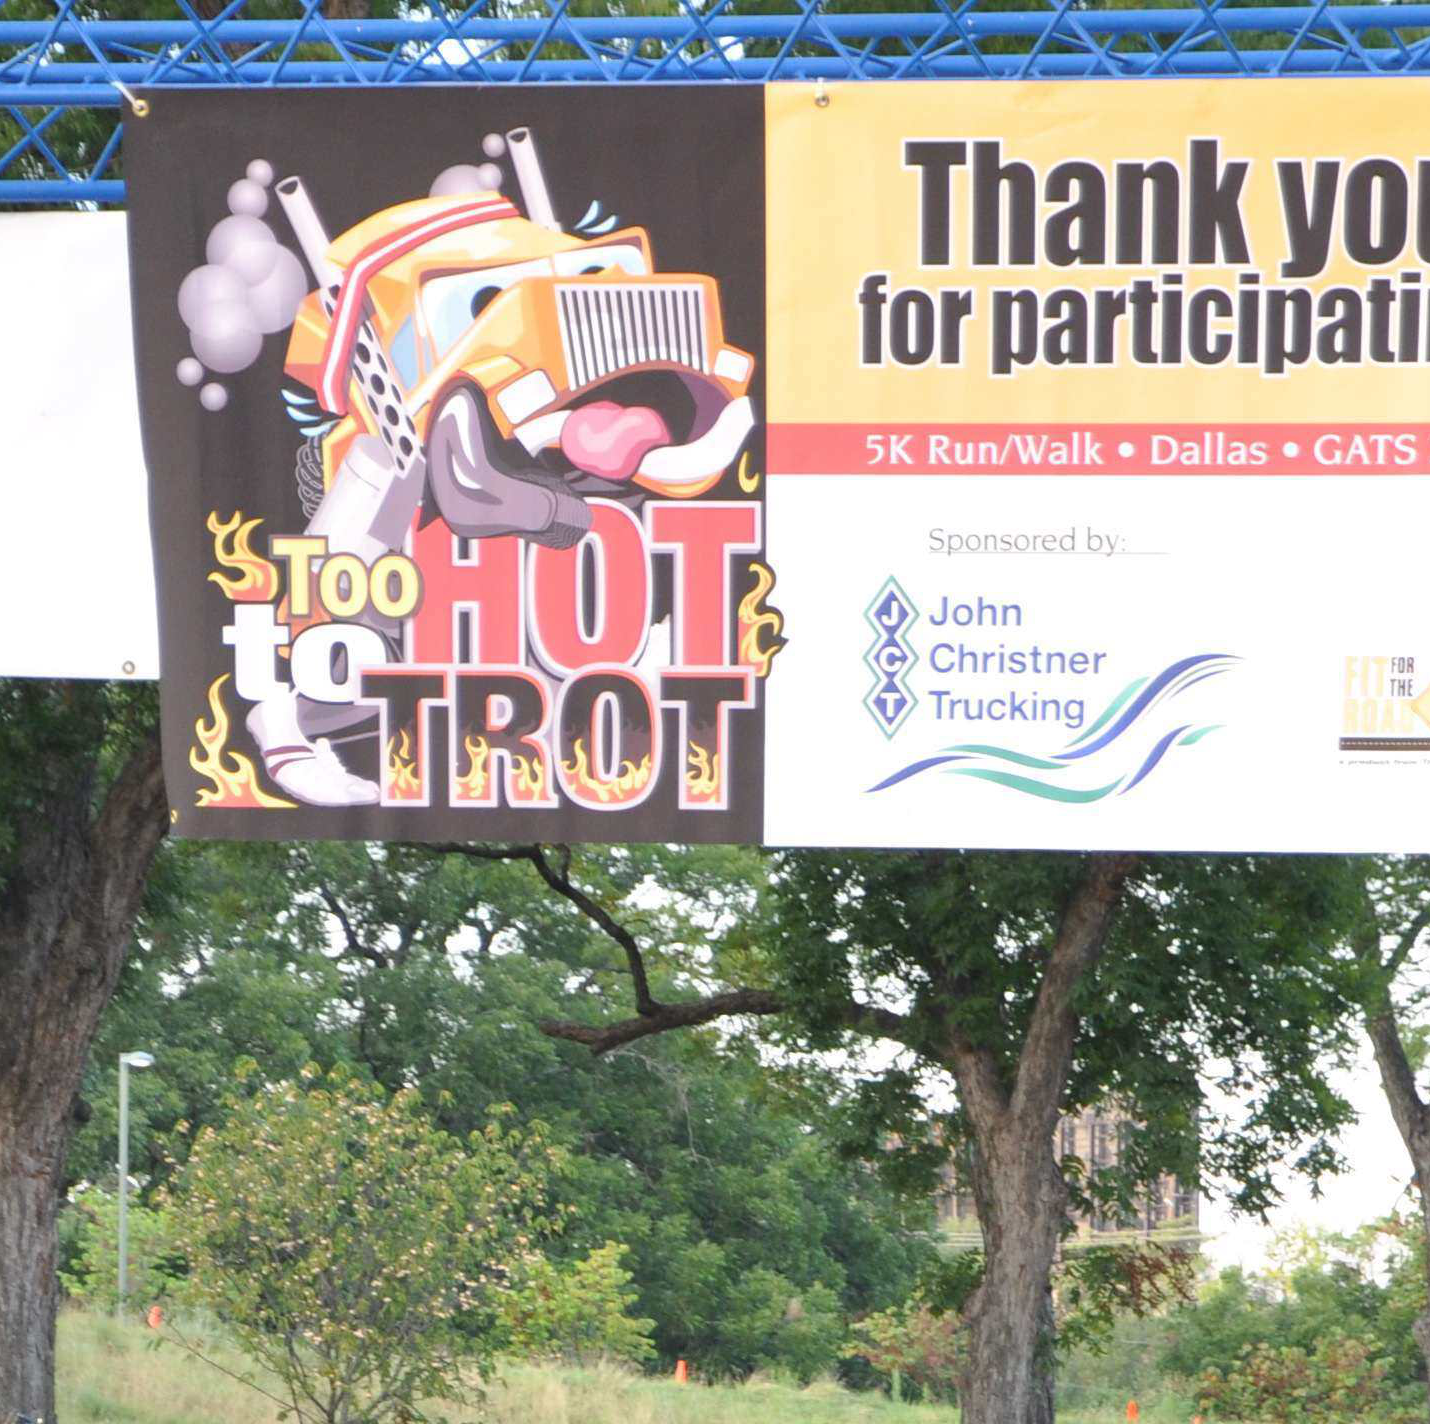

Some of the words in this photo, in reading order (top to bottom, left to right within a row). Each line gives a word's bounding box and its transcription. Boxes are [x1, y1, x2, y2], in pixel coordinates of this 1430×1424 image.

[904, 138, 1251, 267] Thank
[858, 274, 971, 365] for
[865, 433, 914, 465] 5K
[928, 430, 1103, 466] Run/Walk
[1151, 431, 1267, 465] Dallas
[1313, 432, 1417, 465] GATS
[928, 527, 1076, 556] Sponsored
[1087, 527, 1128, 557] by:
[407, 498, 761, 678] HOT
[929, 596, 1022, 626] John
[222, 604, 387, 702] to
[929, 643, 1107, 674] Christner
[1391, 656, 1415, 673] FOR
[1343, 655, 1389, 697] FIT
[1390, 679, 1413, 697] THE
[928, 690, 1085, 729] Trucking
[356, 662, 758, 811] TROT
